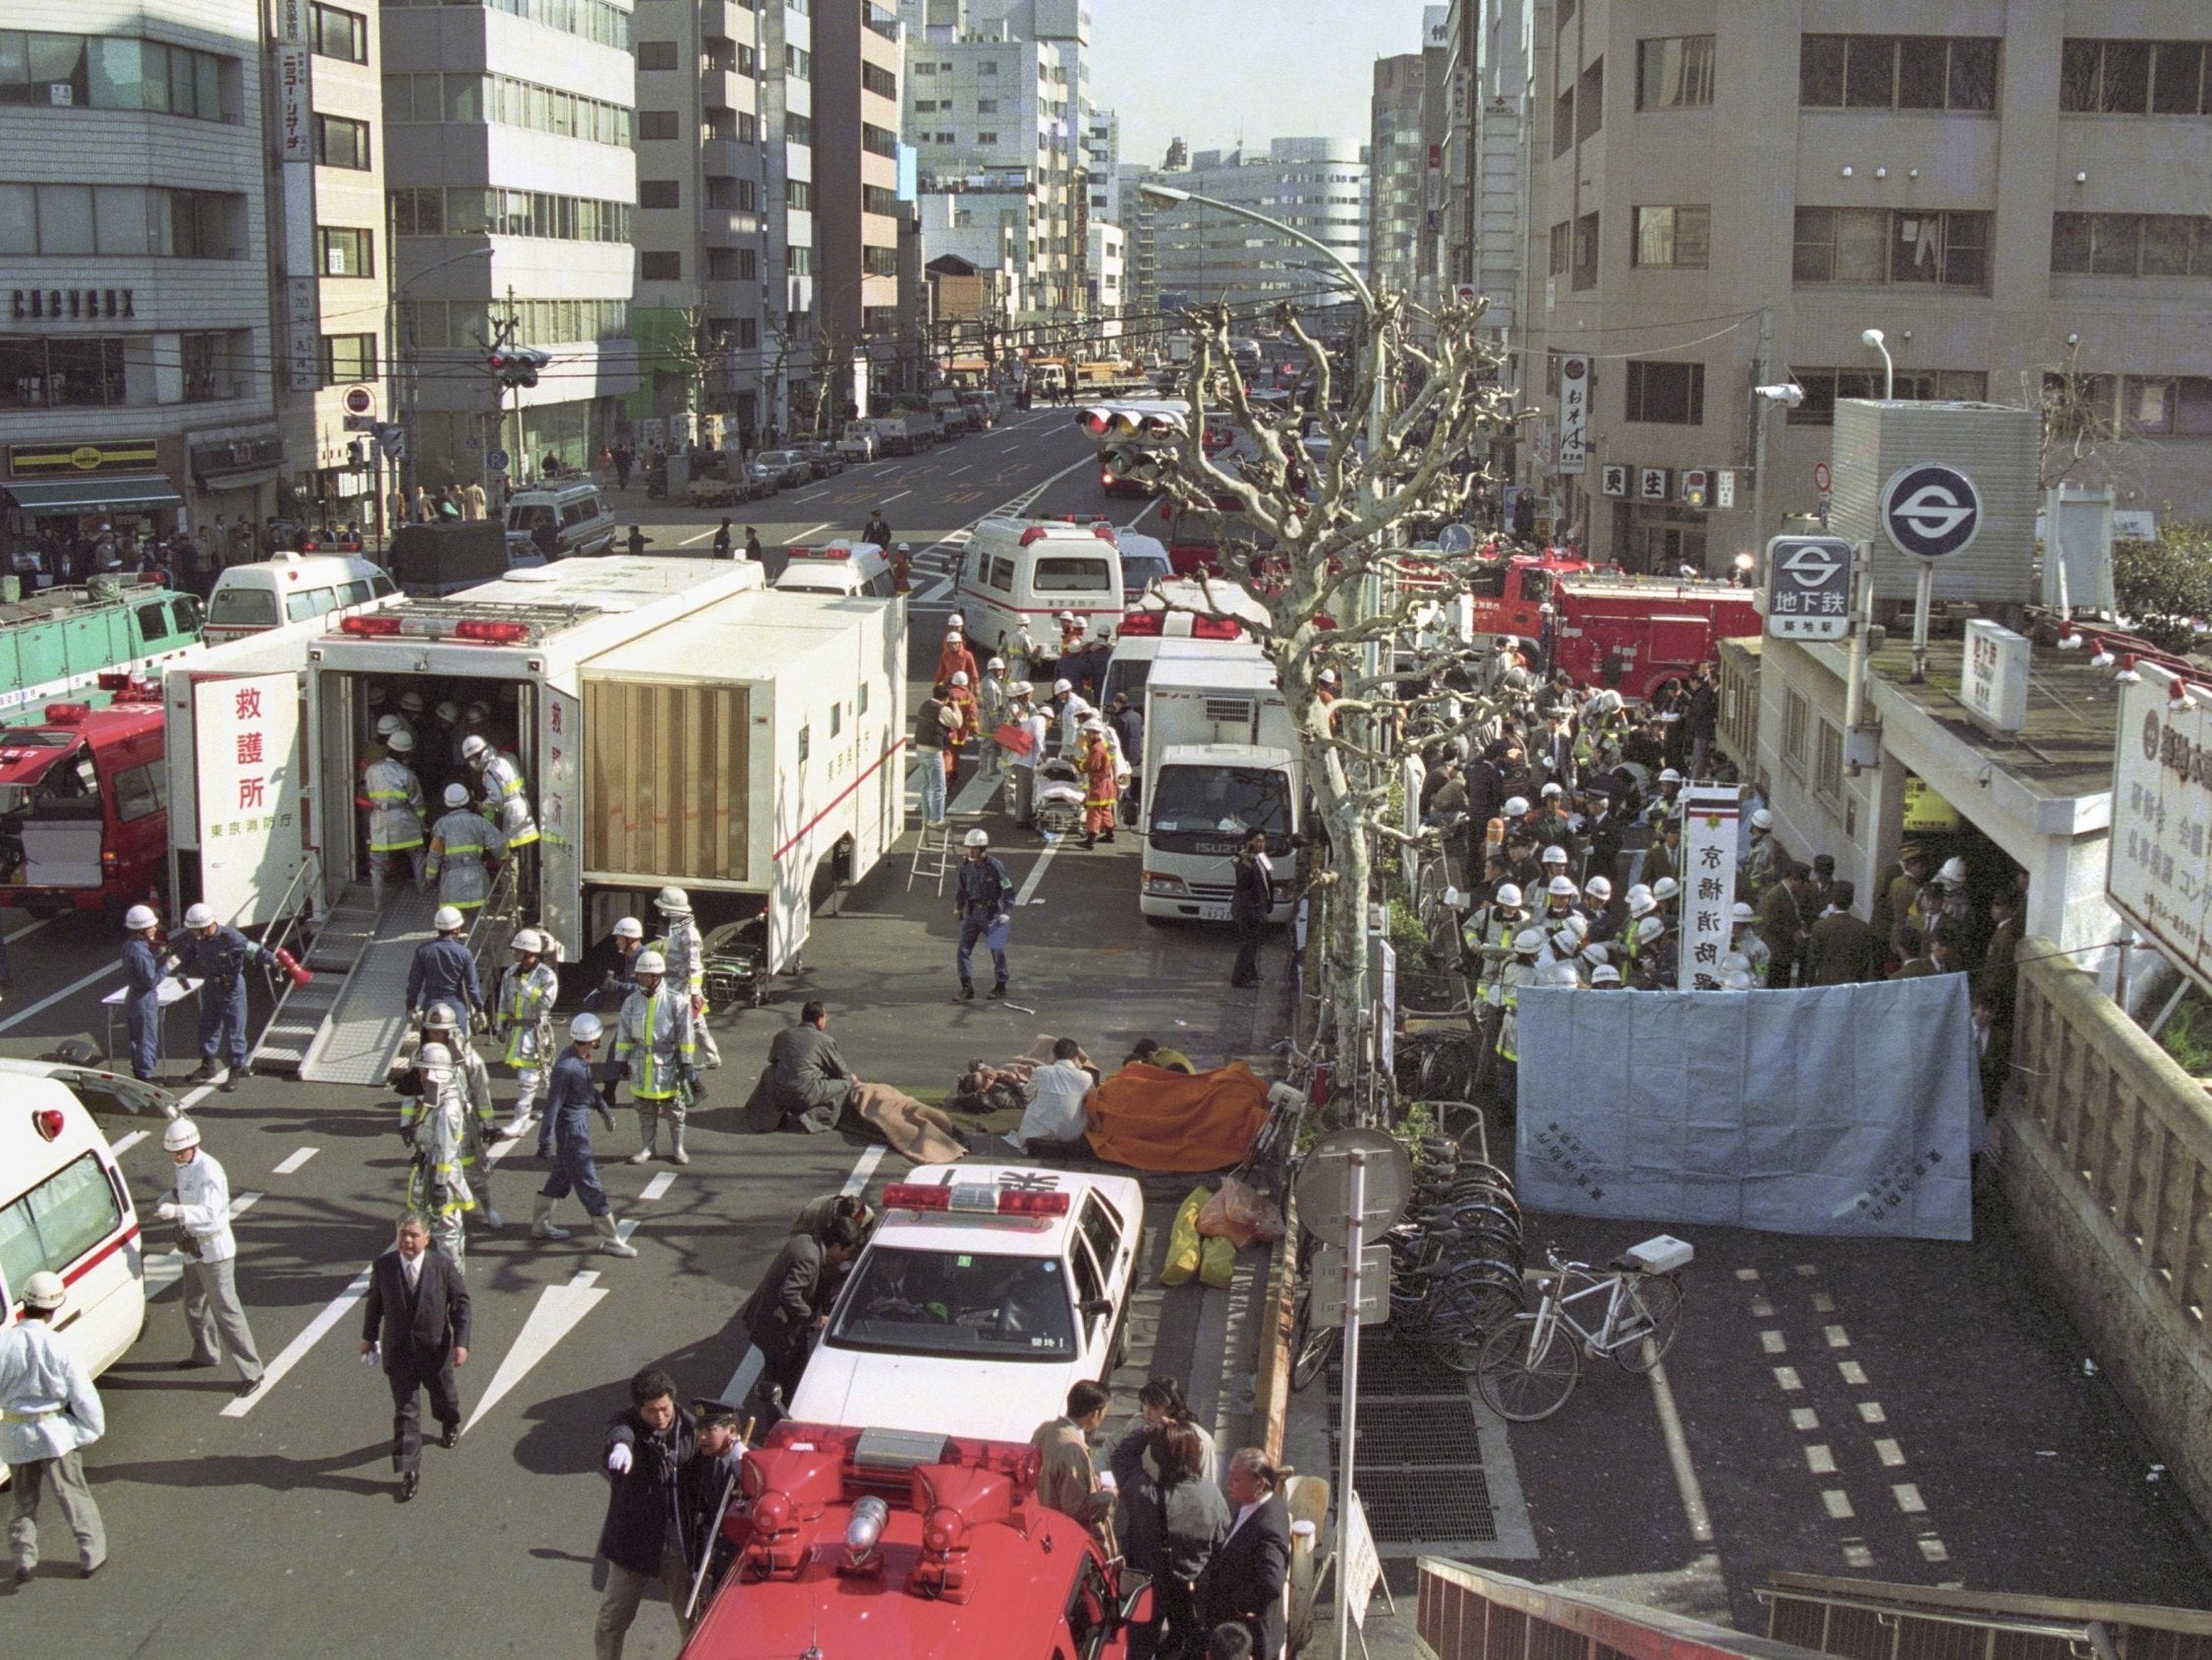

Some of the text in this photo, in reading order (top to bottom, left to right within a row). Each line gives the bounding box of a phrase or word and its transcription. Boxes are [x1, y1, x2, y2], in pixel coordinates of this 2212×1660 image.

[1561, 389, 1585, 449] おそば
[1605, 469, 1692, 497] 更生
[1775, 591, 1844, 613] 地下鉄
[236, 688, 264, 809] 救護所
[210, 813, 292, 837] 東京消防庁
